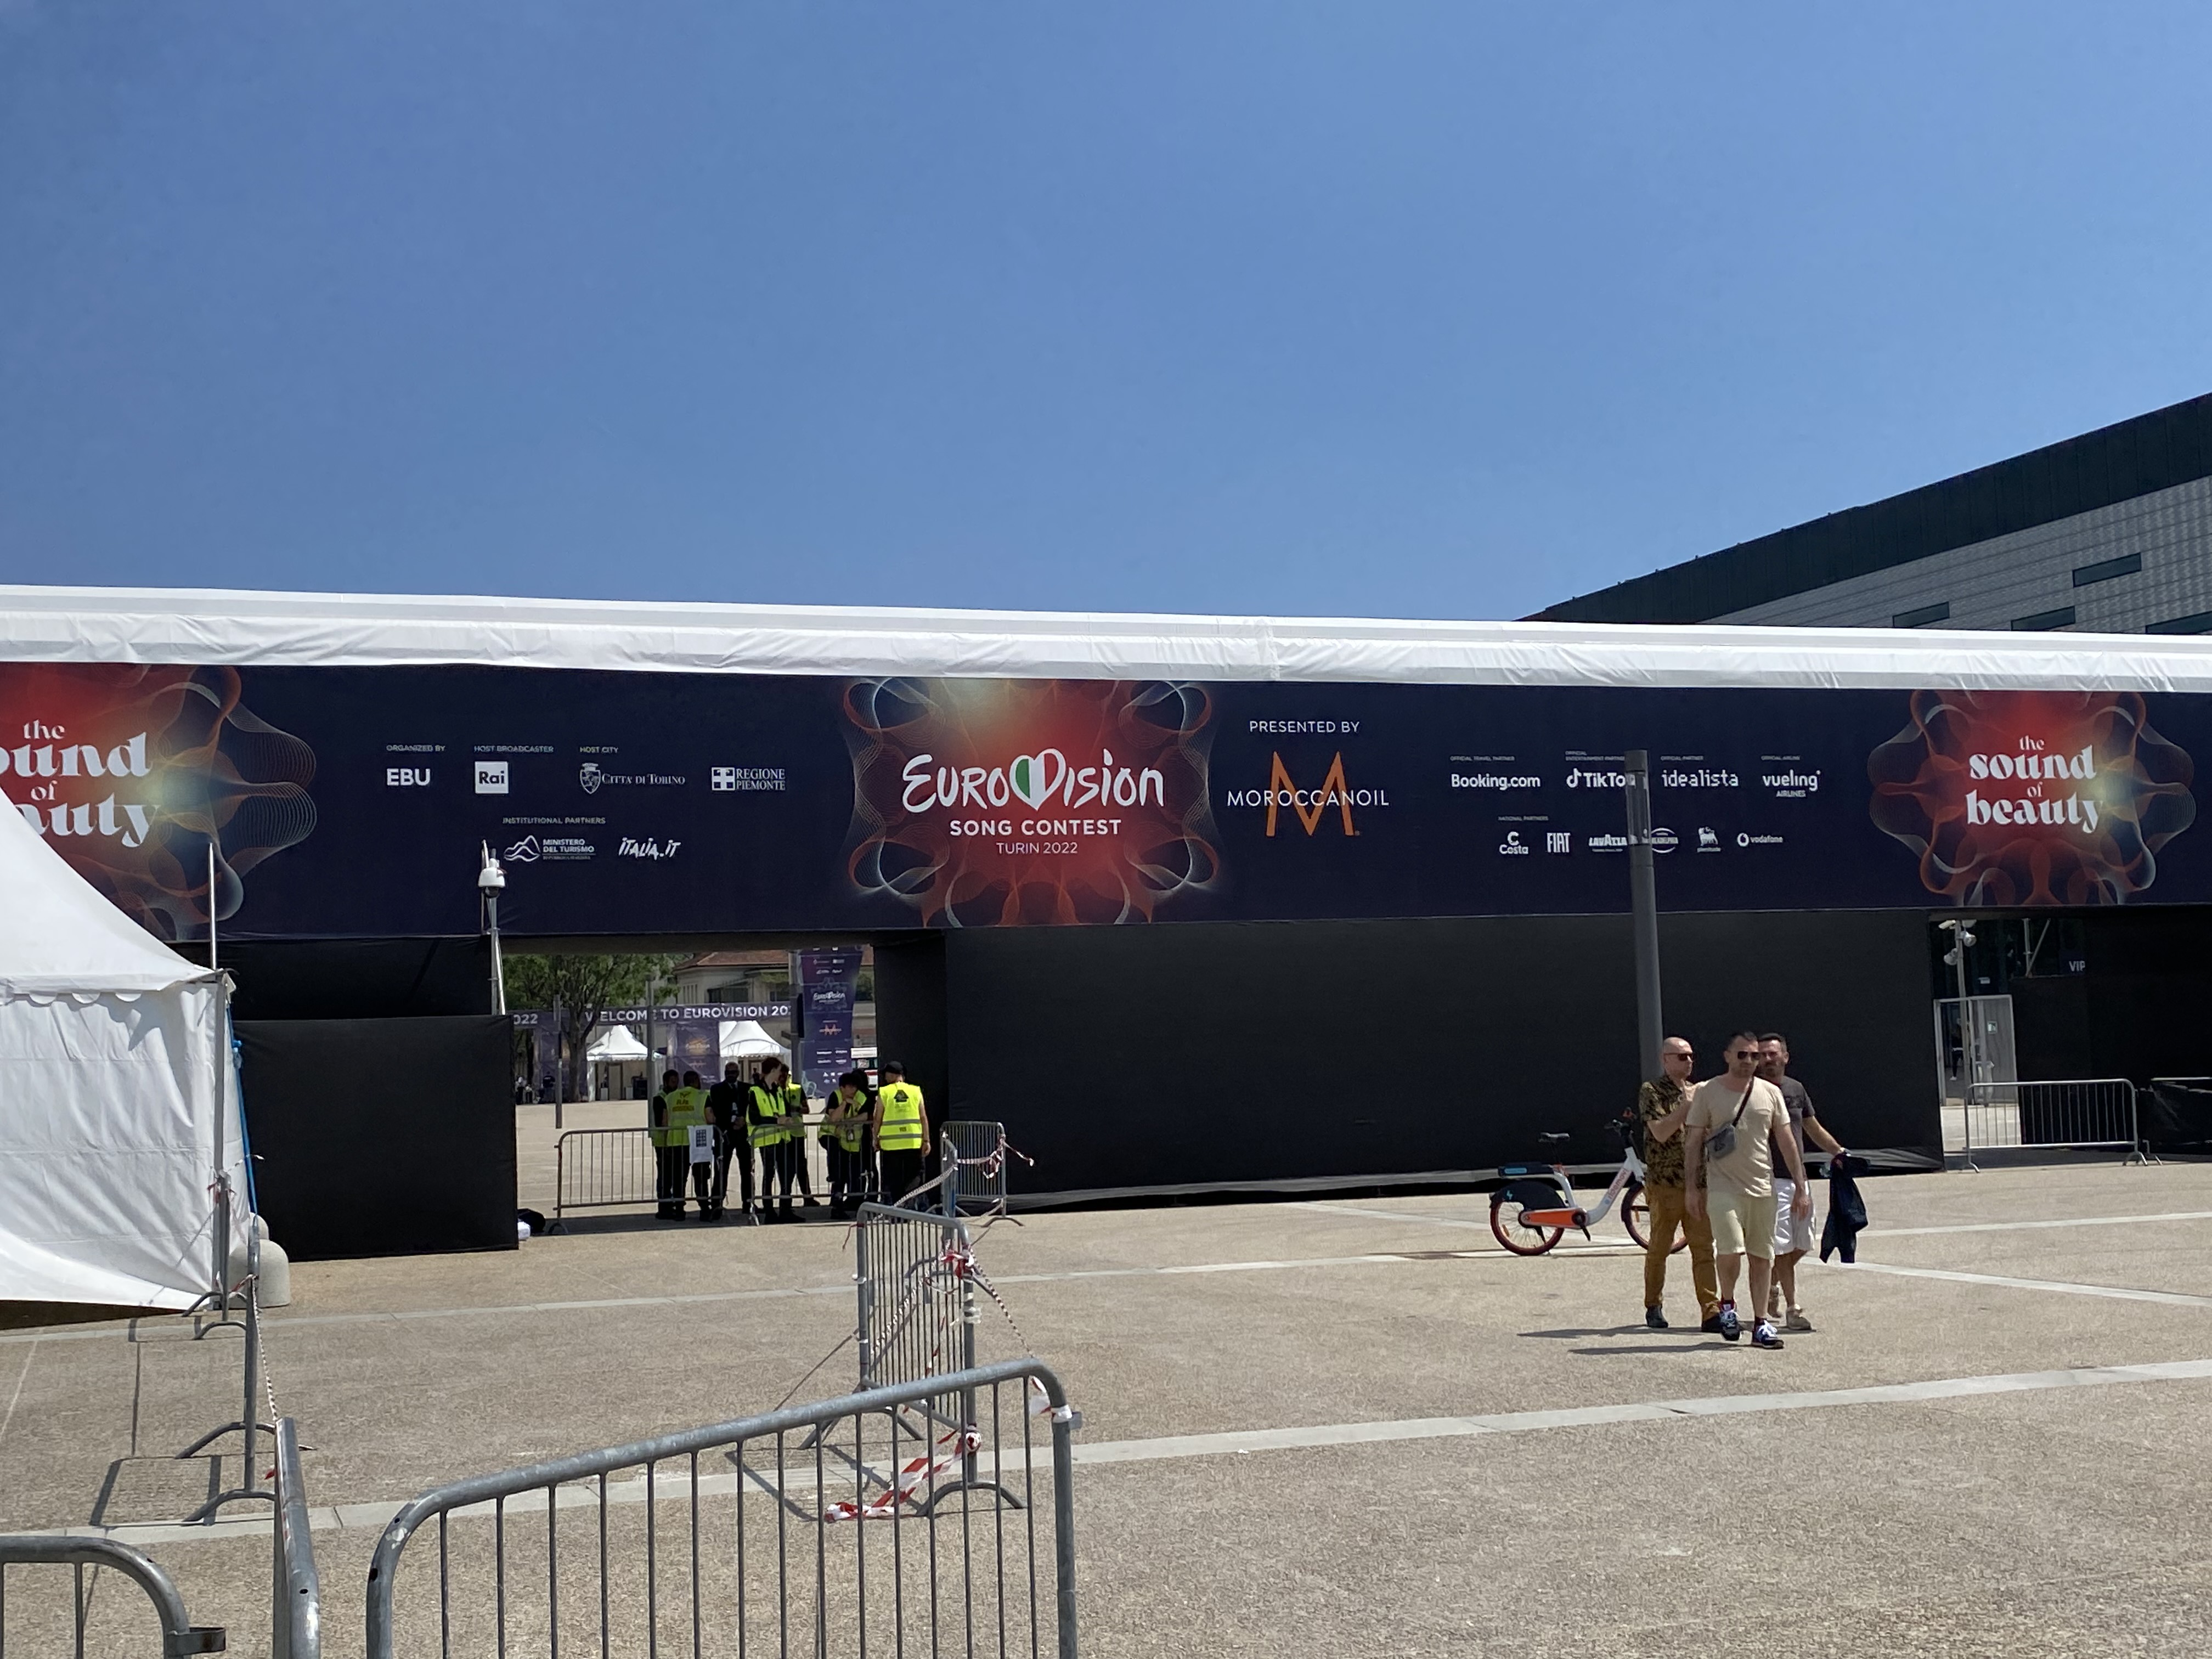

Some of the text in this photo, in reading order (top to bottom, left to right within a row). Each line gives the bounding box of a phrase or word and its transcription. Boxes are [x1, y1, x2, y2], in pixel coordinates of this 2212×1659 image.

[24, 719, 65, 739] the
[1249, 721, 1360, 732] PRESENTED BY
[2019, 735, 2045, 750] the
[0, 732, 153, 777] und
[1969, 744, 2097, 780] sound
[387, 768, 431, 786] EBU
[478, 770, 505, 785] Rai
[736, 769, 786, 780] REGIONE
[1451, 774, 1541, 790] Booking.com
[1583, 772, 1626, 787] TikTo
[1661, 770, 1739, 787] idealista
[1762, 769, 1821, 791] vueling
[31, 780, 58, 800] of
[736, 780, 786, 790] PIEMONTE
[2027, 781, 2043, 797] of
[1227, 789, 1390, 806] MOROCCANOIL
[1966, 789, 2103, 833] beauty
[14, 792, 161, 848] auty
[950, 819, 1122, 836] SONG CONTEST
[1547, 832, 1571, 853] FIAT
[1750, 834, 1783, 843] vodafone
[996, 842, 1078, 854] TURIN 2022
[1499, 844, 1528, 854] Costa
[2068, 960, 2085, 972] VIP
[513, 1014, 538, 1025] 022
[660, 1009, 680, 1020] TO
[684, 1006, 768, 1019] EUROVISION
[771, 1005, 791, 1016] 20
